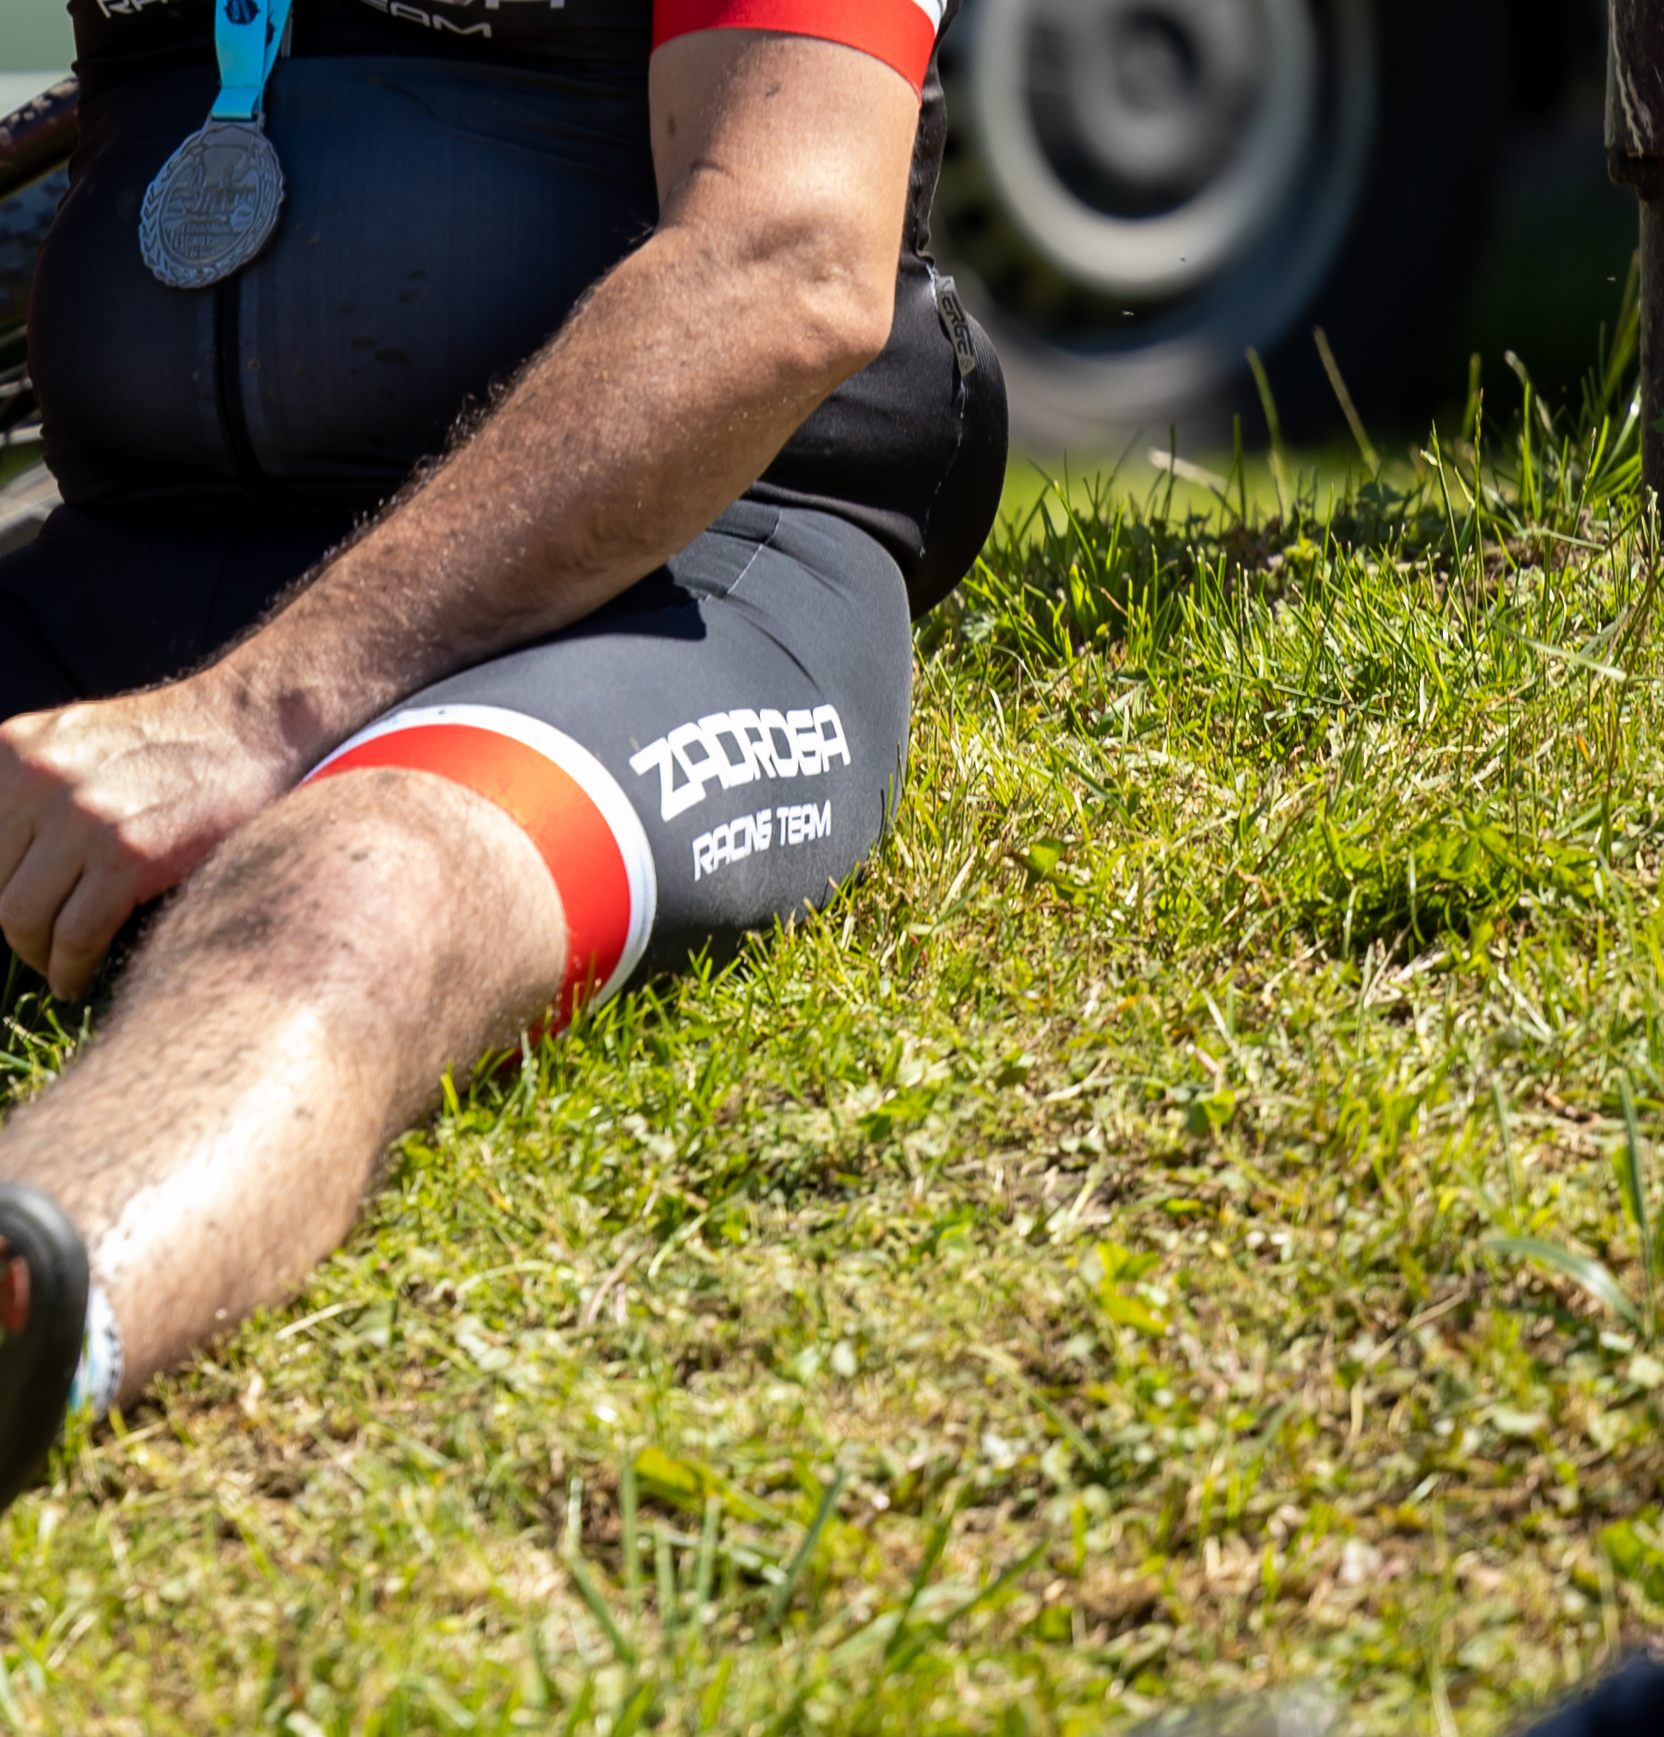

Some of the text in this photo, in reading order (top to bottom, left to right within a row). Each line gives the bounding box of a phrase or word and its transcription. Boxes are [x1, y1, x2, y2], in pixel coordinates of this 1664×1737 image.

[628, 703, 852, 823] ZADROGA
[691, 799, 832, 883] RACING TEAM
